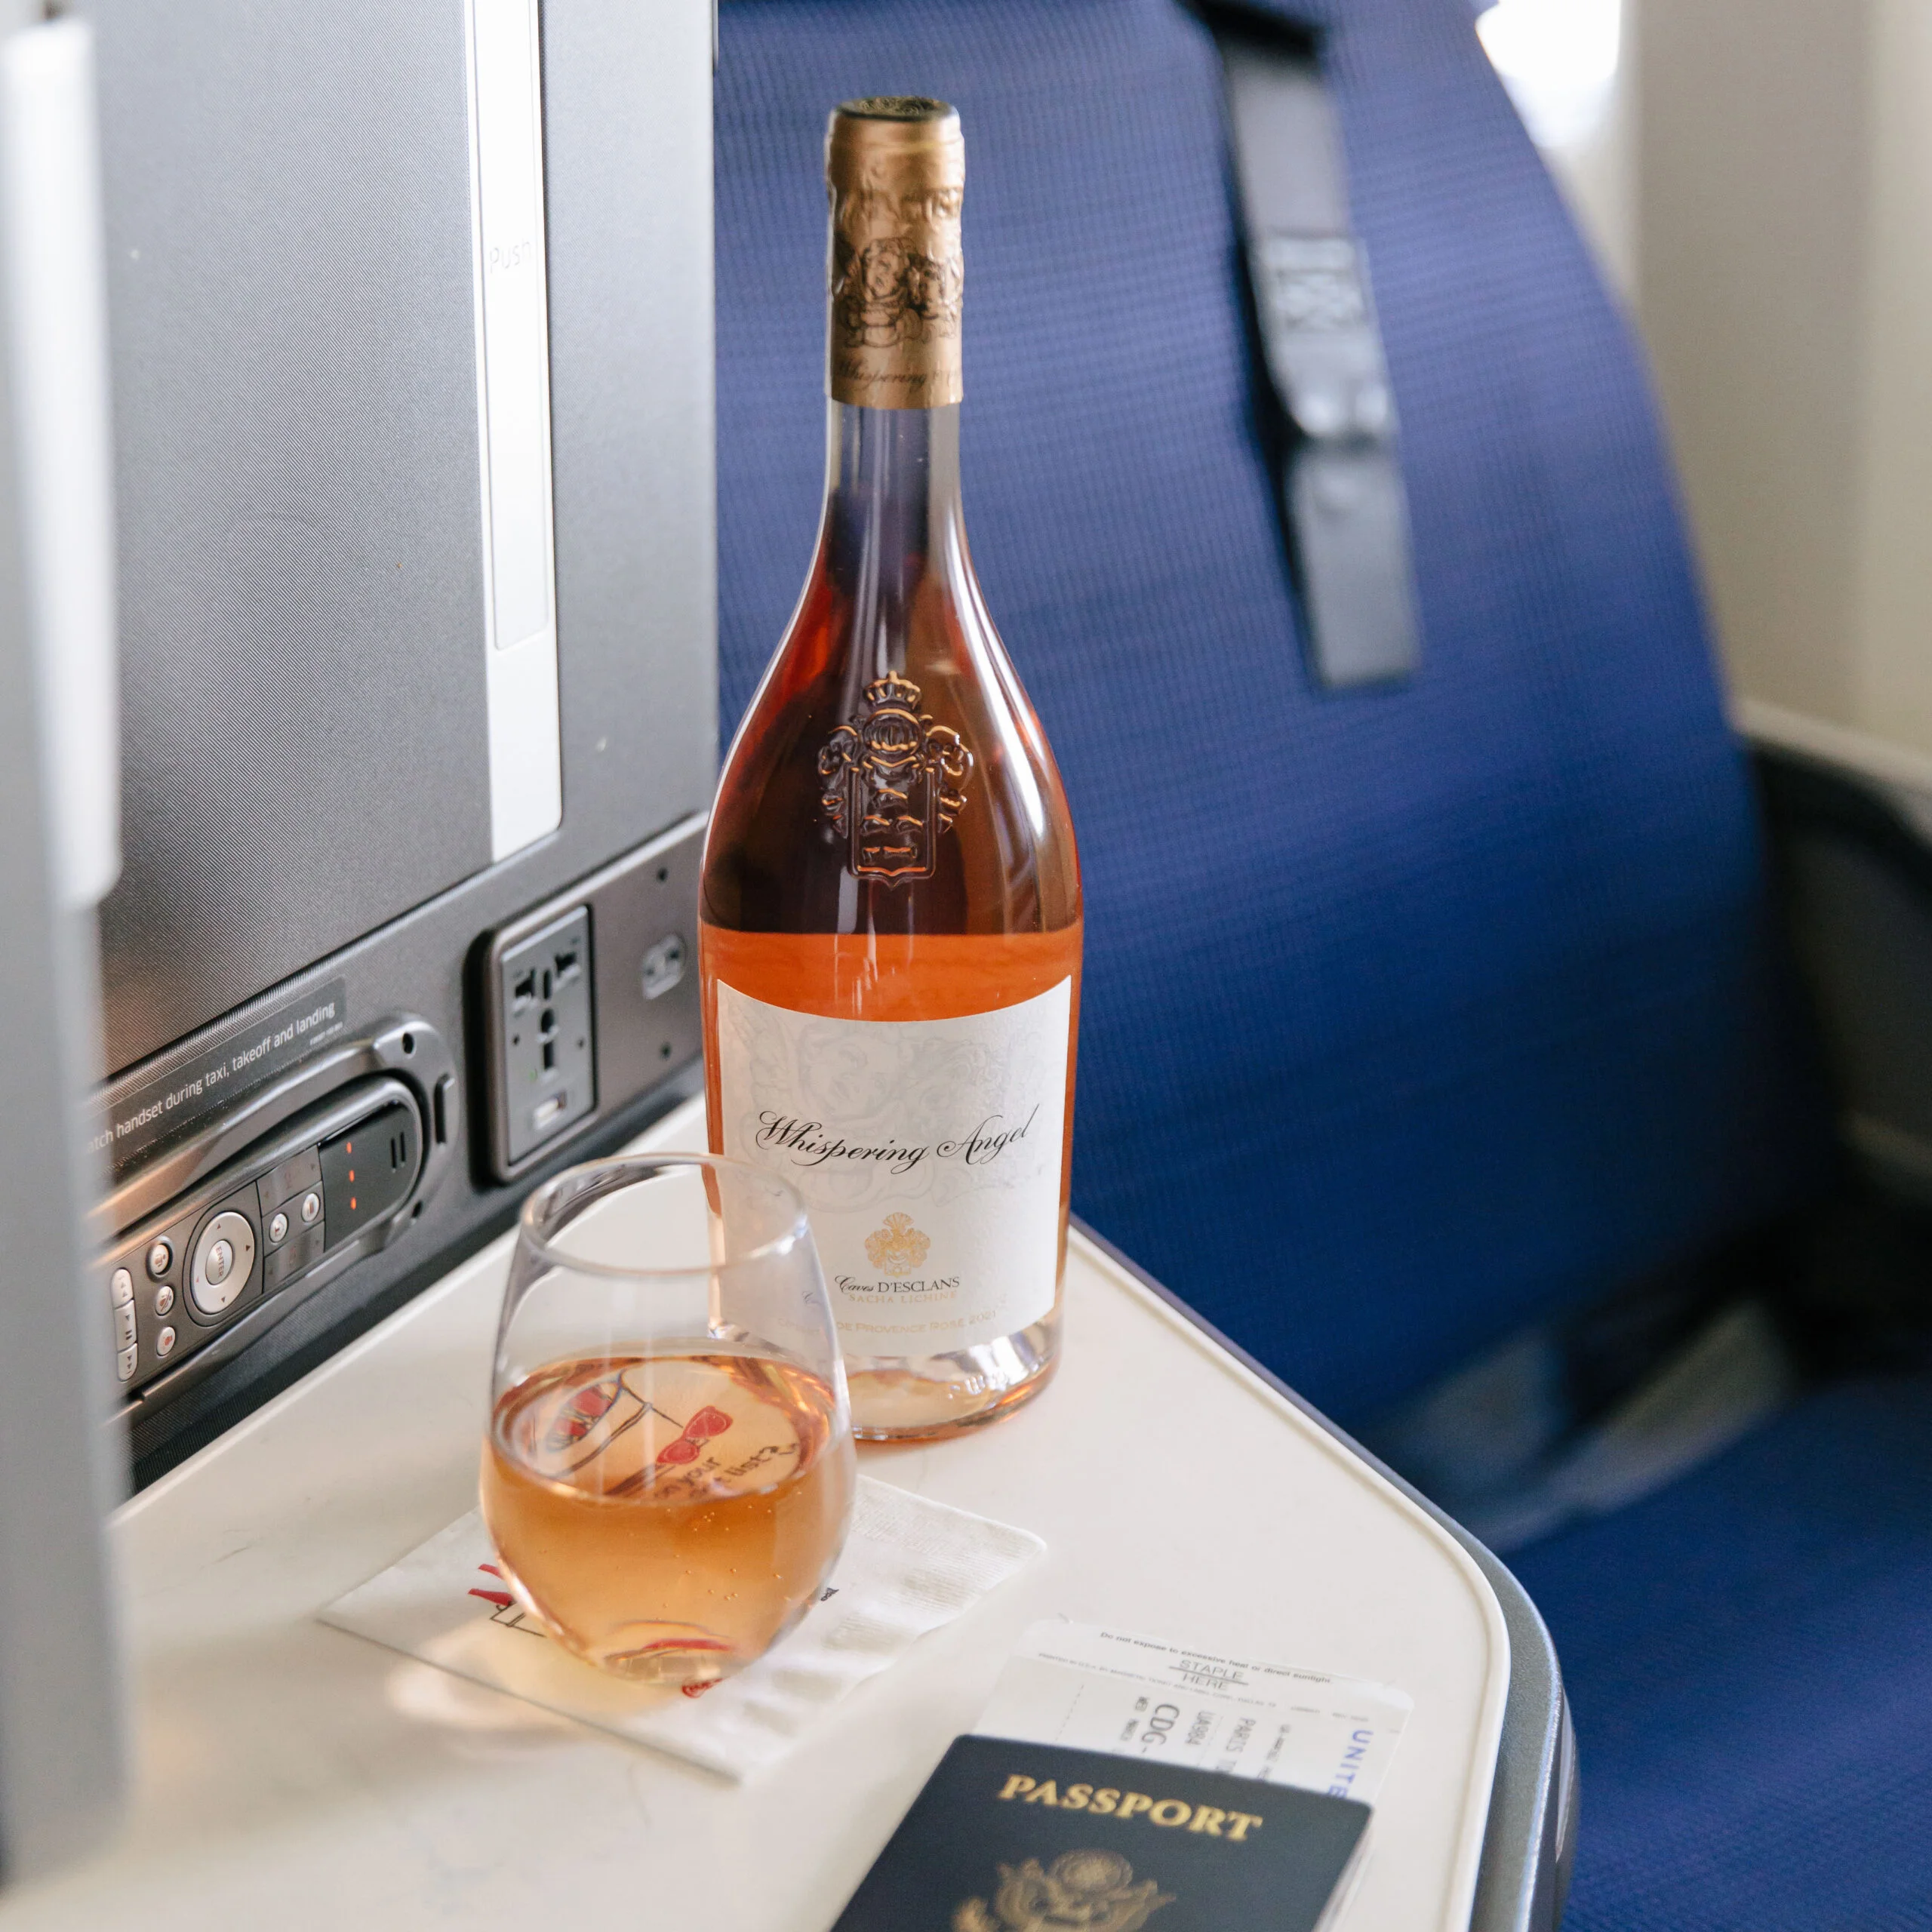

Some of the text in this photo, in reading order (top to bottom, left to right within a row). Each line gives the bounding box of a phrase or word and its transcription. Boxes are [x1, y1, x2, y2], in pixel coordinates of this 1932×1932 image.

[116, 1100, 164, 1138] handset
[165, 1077, 204, 1110] during
[205, 1061, 230, 1088] taxi,
[232, 1035, 272, 1072] takeoff
[273, 1022, 294, 1048] and
[296, 1001, 336, 1035] landing
[755, 1103, 1040, 1174] Whispering Angel
[216, 1246, 224, 1278] ENTER
[834, 1275, 960, 1294] Caves D'ESCLANS
[848, 1290, 958, 1304] SACHA LICHINE
[855, 1322, 926, 1334] PROVENCE
[1100, 1632, 1114, 1640] Do
[1115, 1636, 1131, 1644] not
[1134, 1640, 1167, 1653] expose
[1181, 1649, 1226, 1664] excessive
[1229, 1660, 1249, 1669] heat
[1263, 1666, 1291, 1677] direct
[1179, 1659, 1245, 1681] STAPLE
[1182, 1672, 1229, 1692] HERE
[1226, 1718, 1256, 1753] PARIS
[998, 1774, 1263, 1841] PASSPORT
